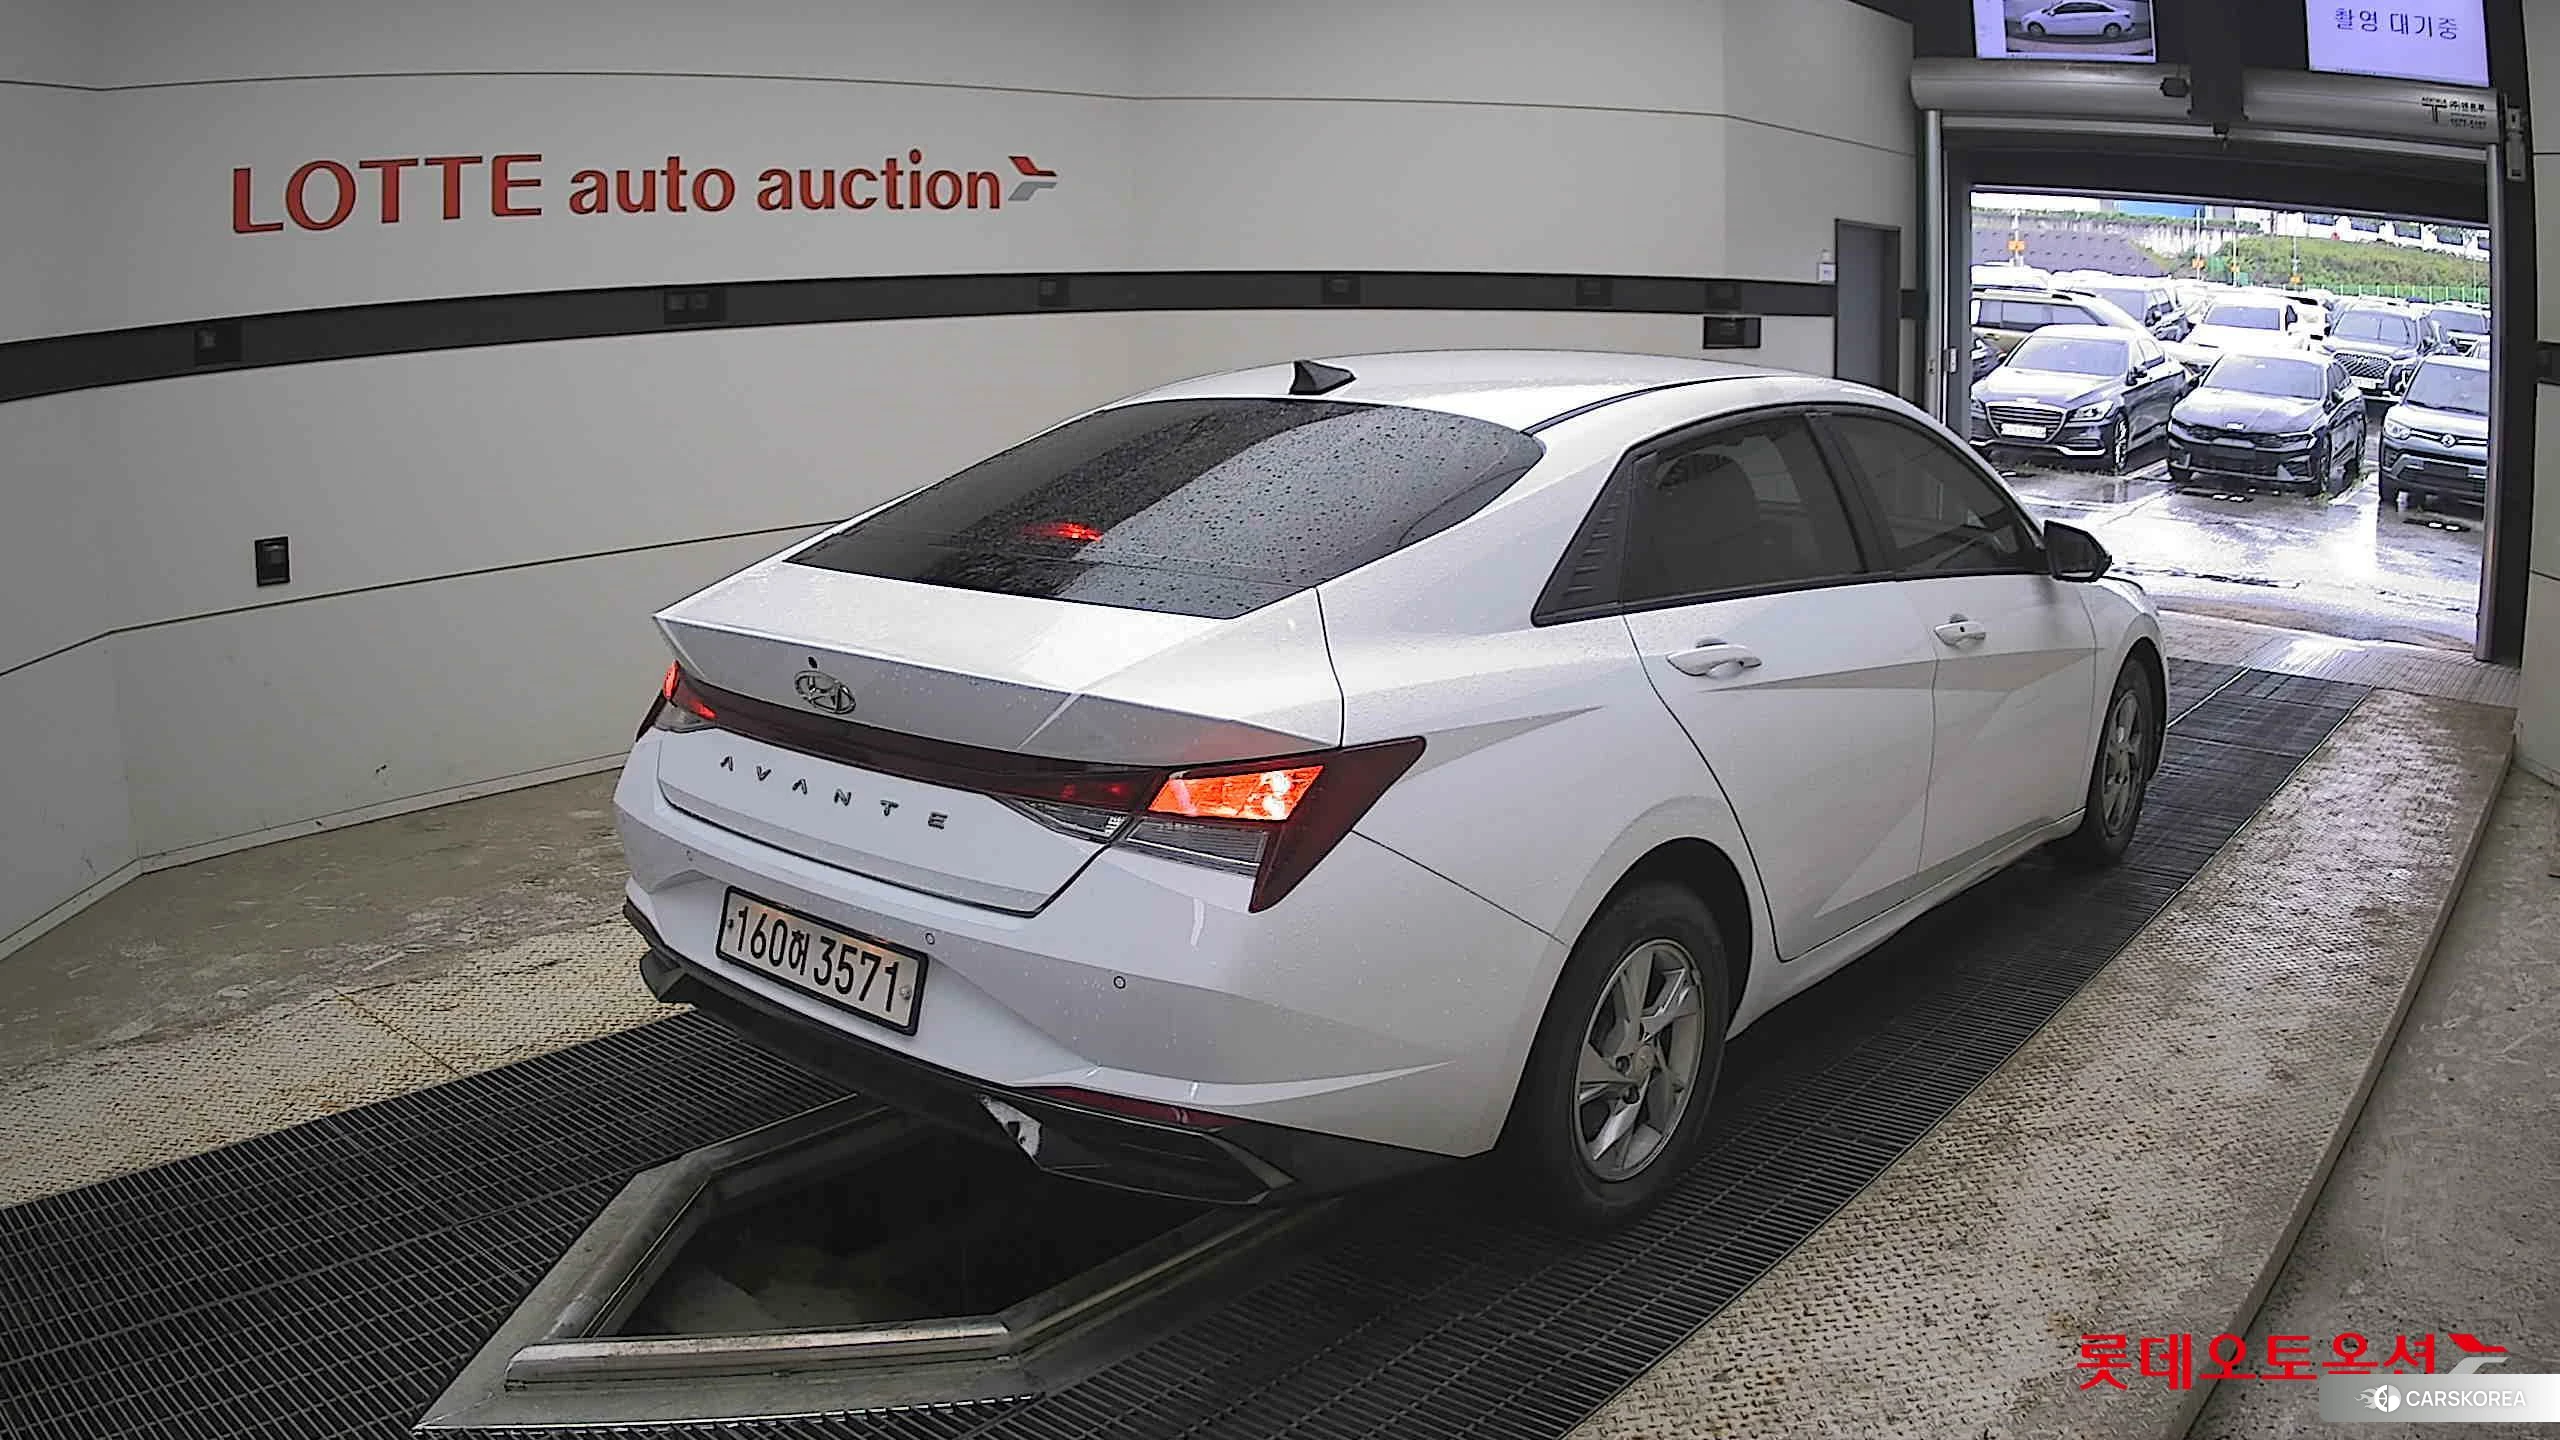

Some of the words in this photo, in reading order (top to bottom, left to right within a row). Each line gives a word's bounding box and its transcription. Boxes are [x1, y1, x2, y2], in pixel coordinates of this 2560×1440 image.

[233, 154, 543, 234] LOTTE
[569, 156, 736, 213] auto
[757, 149, 1002, 209] auction
[720, 756, 948, 829] AVANTE
